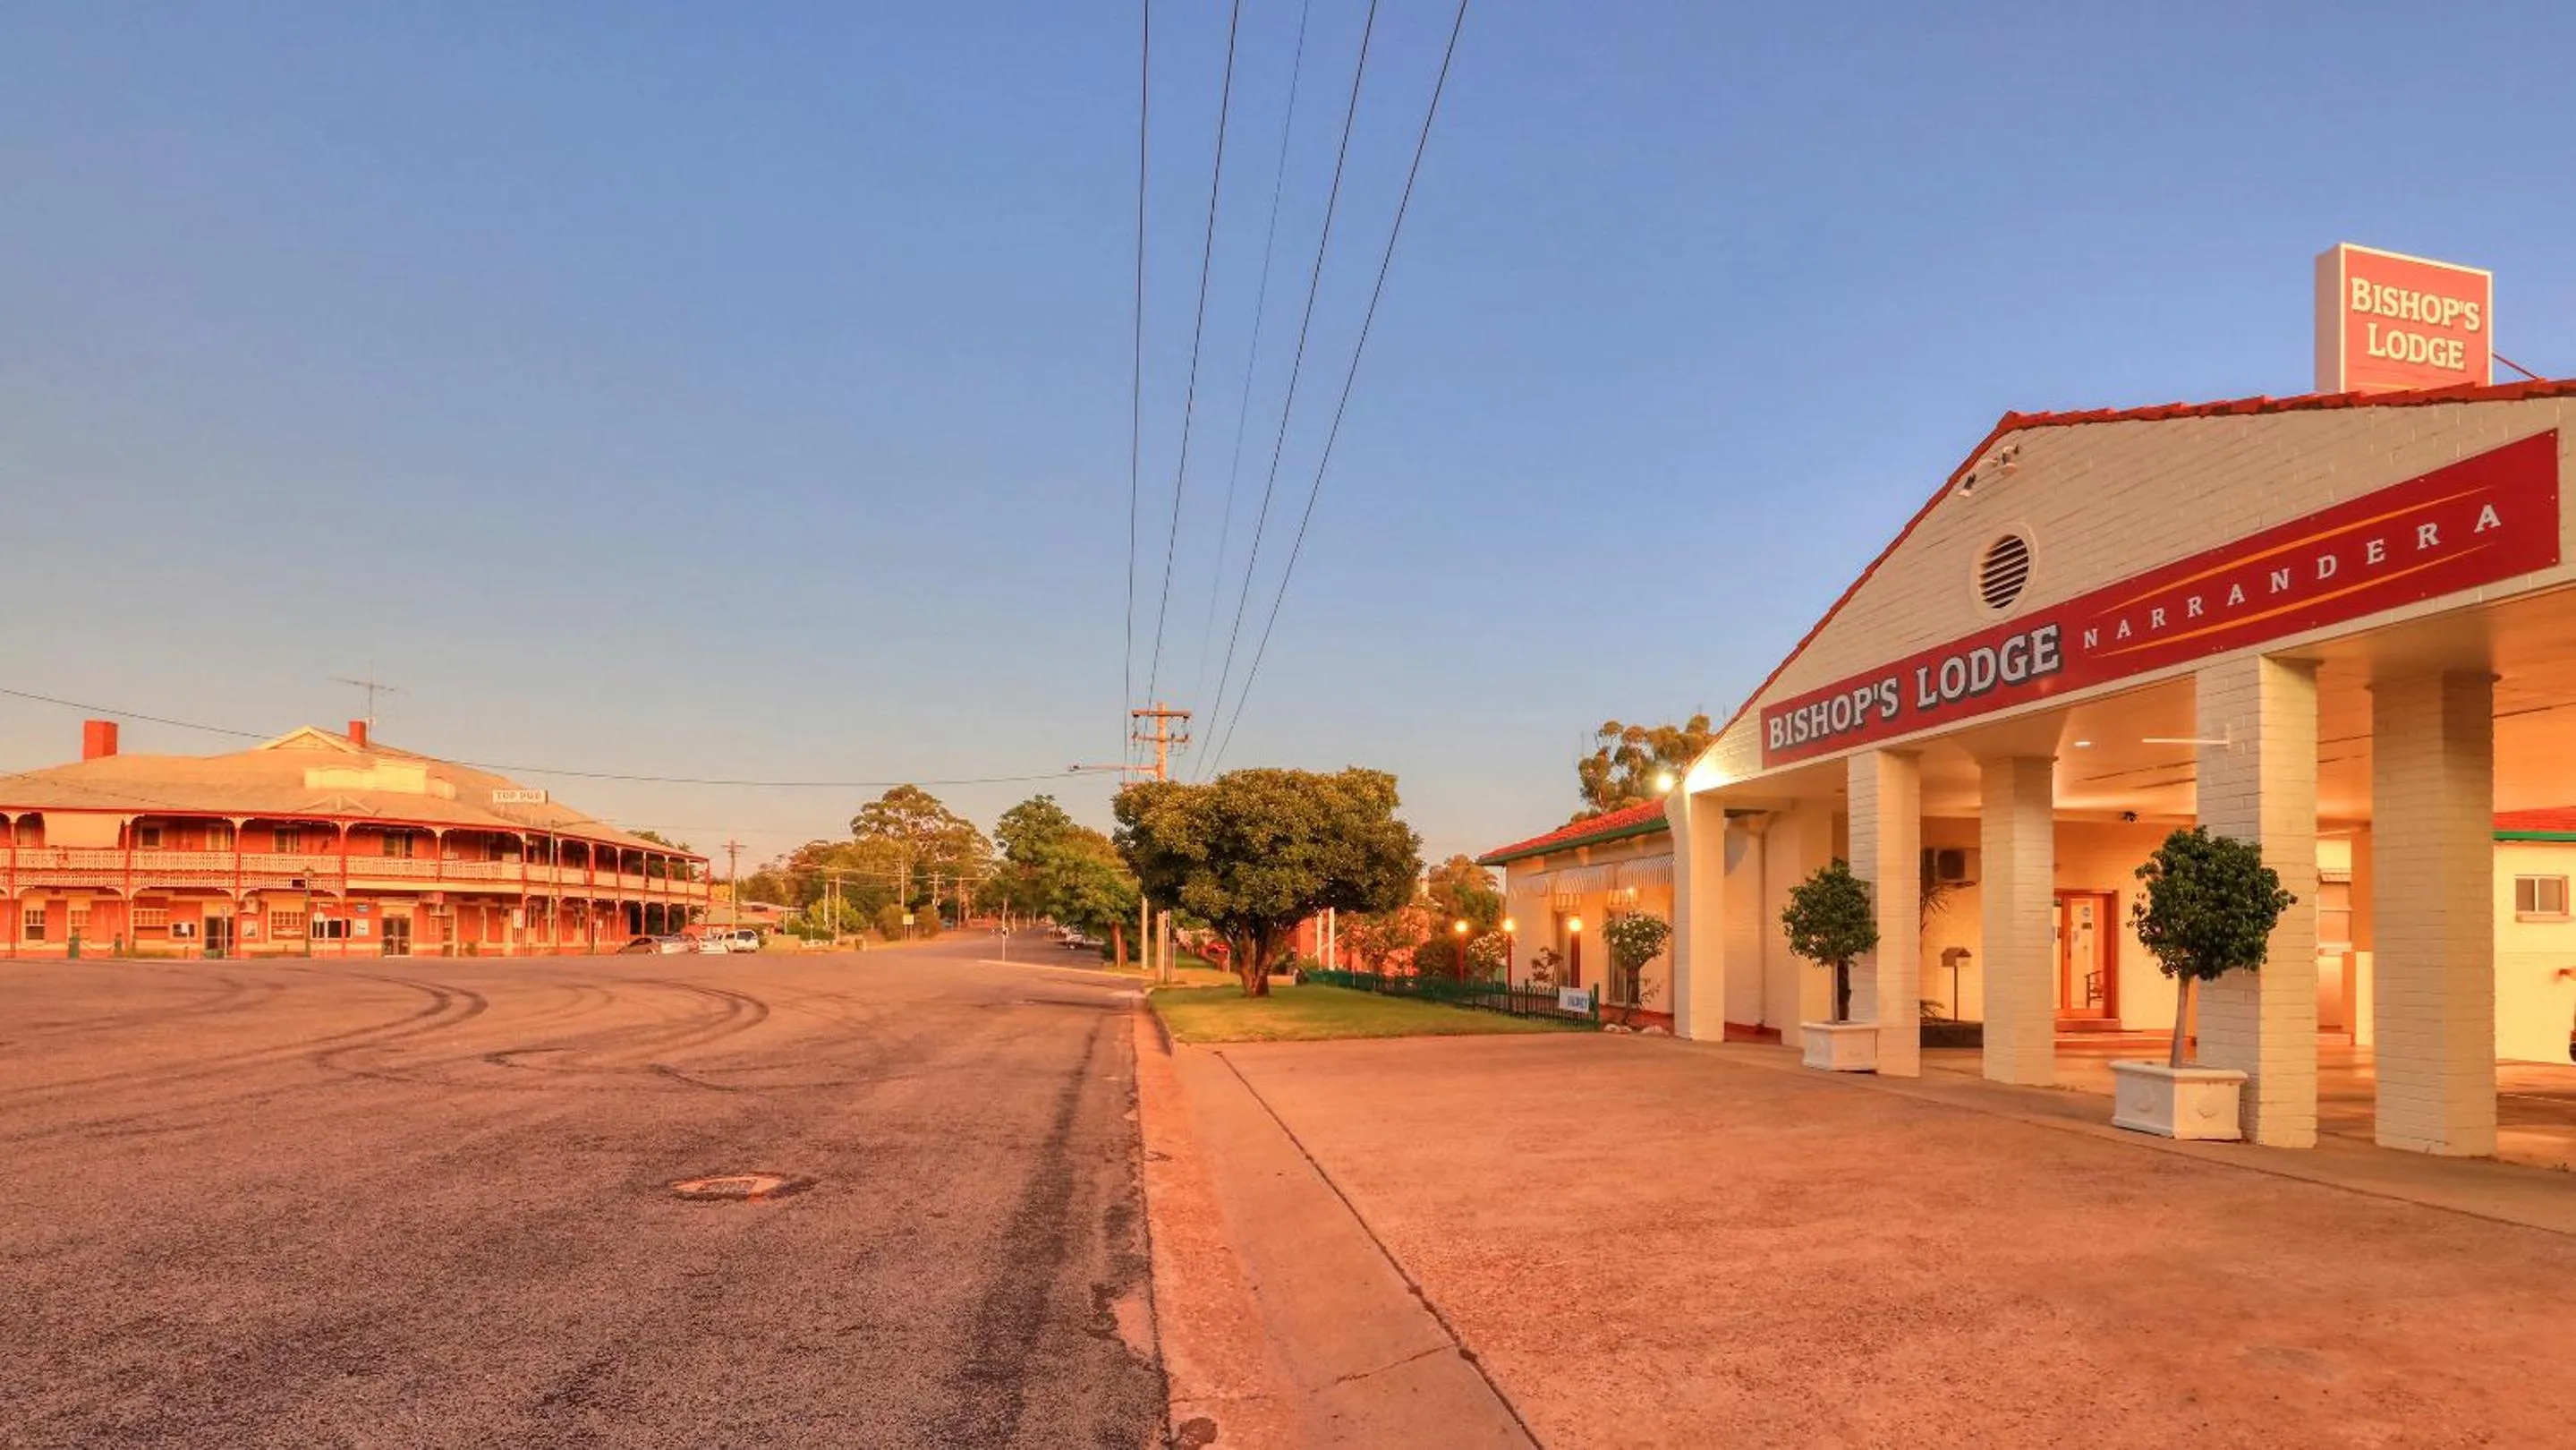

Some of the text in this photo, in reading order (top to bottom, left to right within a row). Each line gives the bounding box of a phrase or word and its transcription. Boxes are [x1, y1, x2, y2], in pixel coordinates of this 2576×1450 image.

[2351, 277, 2481, 332] BISHOP'S
[2367, 321, 2466, 371] LODGE
[2083, 504, 2502, 649] NARRANDERA
[1768, 624, 2061, 750] BISHOP'S LODGE
